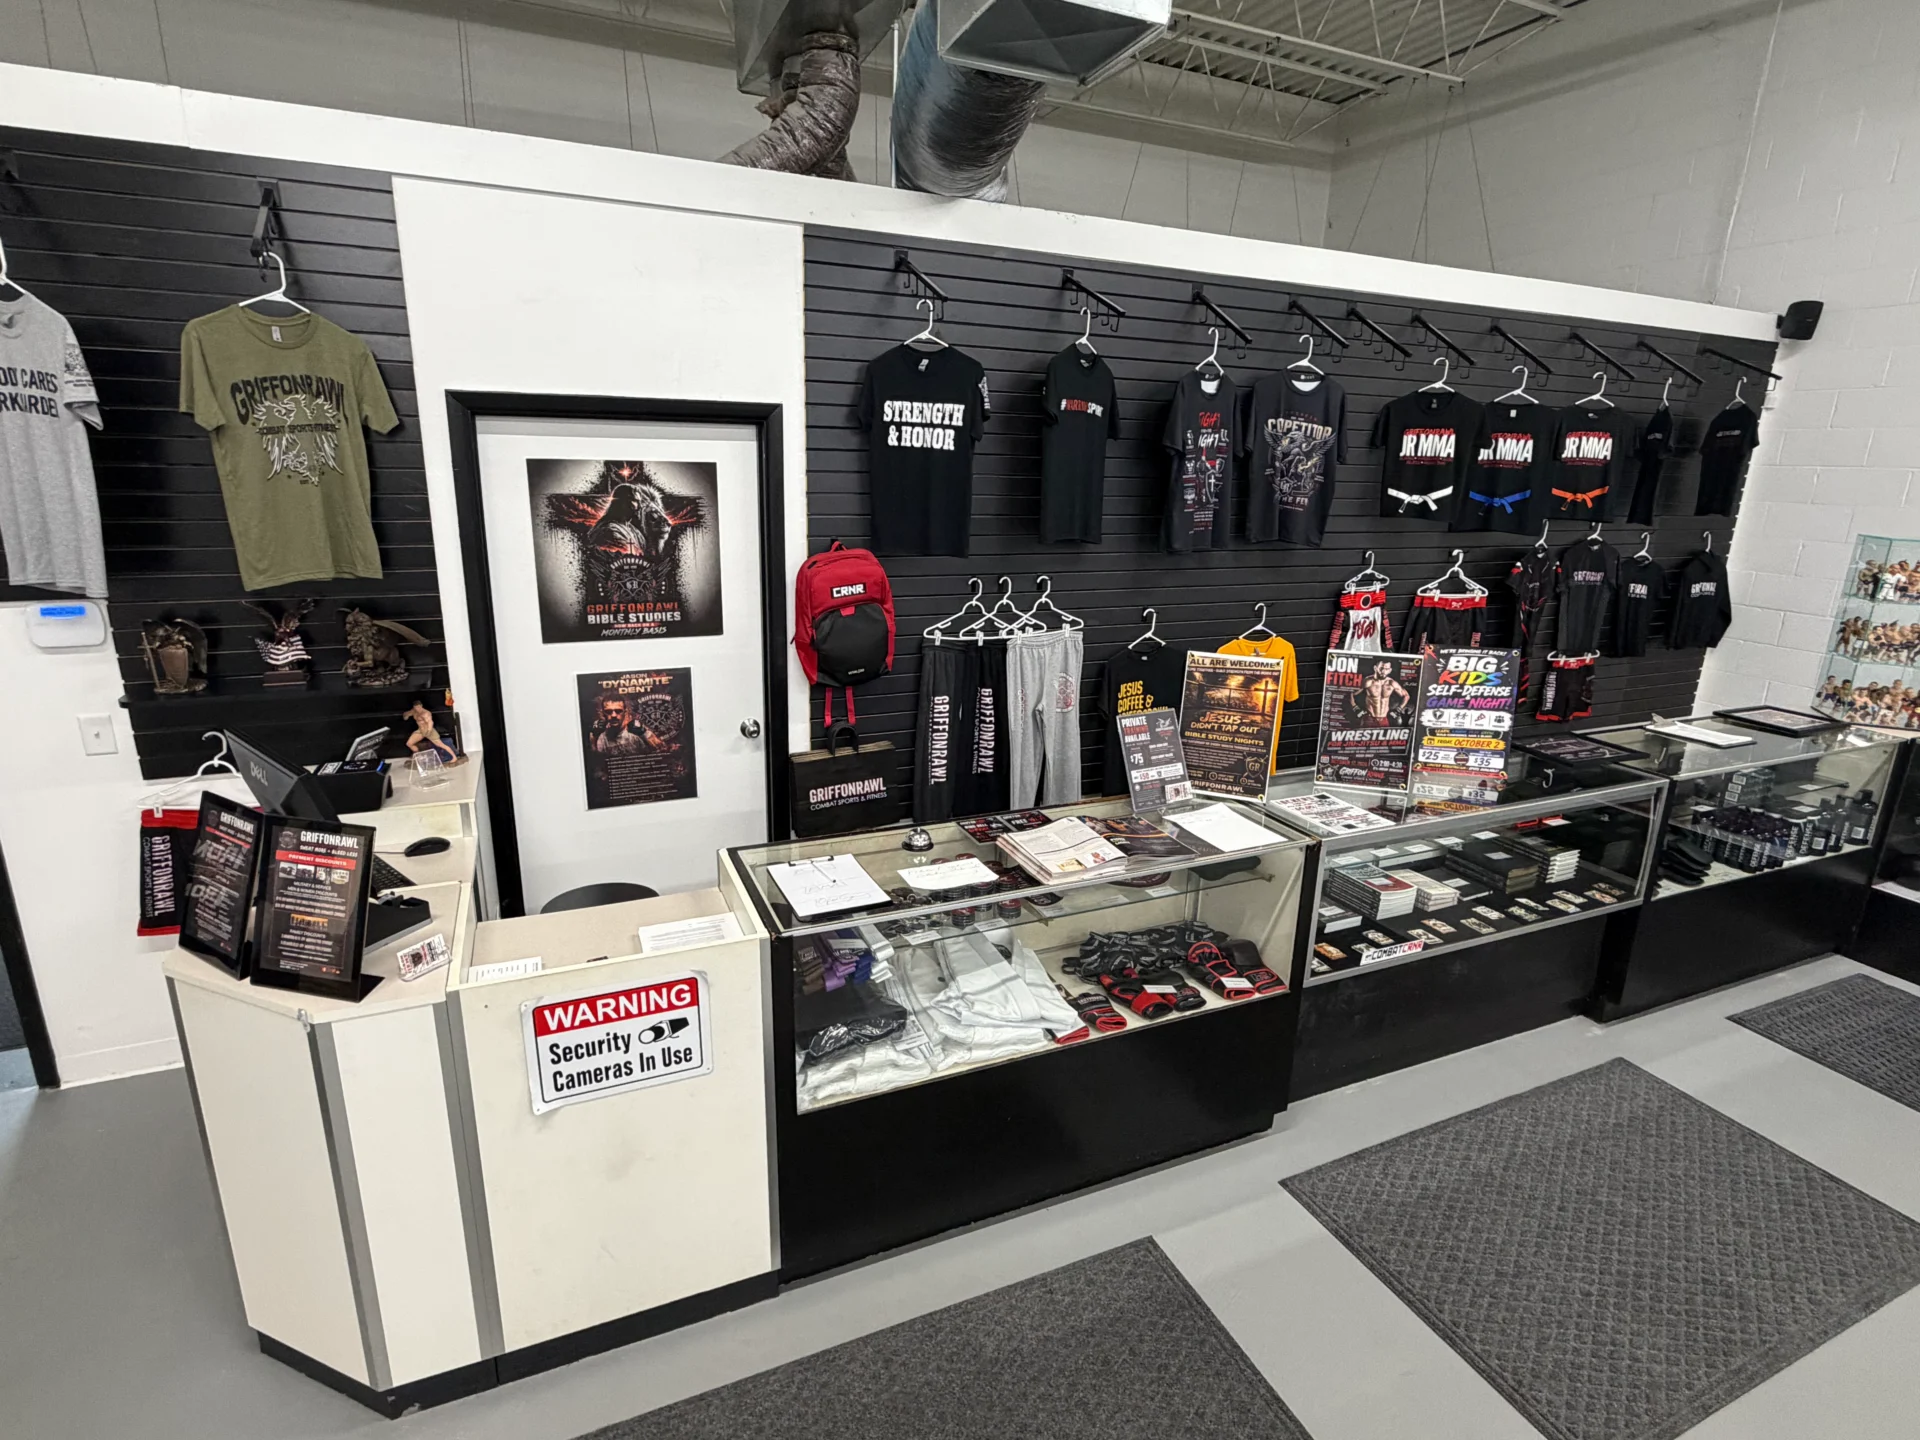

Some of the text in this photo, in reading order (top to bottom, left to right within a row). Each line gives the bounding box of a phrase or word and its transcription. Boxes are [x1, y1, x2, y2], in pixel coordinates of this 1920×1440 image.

[21, 368, 58, 394] CARES
[883, 400, 966, 427] STRENGTH
[887, 425, 955, 451] & HONOR
[1399, 433, 1456, 458] JR MMA
[1496, 438, 1534, 462] MMA
[1562, 437, 1613, 460] JR MMA
[587, 611, 682, 624] BIBLE STUDIES
[601, 626, 667, 636] MONTHLY BASIS
[1190, 658, 1275, 669] ALL ARE WELCOME
[1328, 657, 1359, 673] JON
[1446, 656, 1498, 673] BIG
[1326, 672, 1363, 687] FITCH
[1438, 670, 1504, 686] KIDS
[619, 685, 653, 694] DENT
[1118, 681, 1143, 698] JESUS
[1426, 684, 1512, 697] SELF-DEFENSE
[1118, 695, 1145, 713] COFFEE
[1145, 694, 1154, 708] &
[1426, 696, 1513, 709] GAME NIGHT!
[1121, 716, 1148, 728] PRIVATE
[1200, 712, 1242, 724] JESUS
[978, 688, 995, 773] GRIFFONRAWL
[1190, 721, 1260, 735] DIDN'T TAP OUT
[1331, 729, 1410, 741] WRESTLING
[931, 695, 950, 785] GRIFFONRAWL
[1124, 732, 1151, 743] AVAILABLE
[1208, 733, 1234, 742] STUDY
[1234, 737, 1264, 746] NIGHTS
[1453, 739, 1492, 748] OCTOBER
[1493, 741, 1500, 749] 2
[1130, 752, 1144, 764] $75
[1421, 750, 1440, 760] $25
[1473, 757, 1492, 767] $35
[250, 761, 269, 786] DELL
[1339, 766, 1368, 777] GRIFFON
[809, 777, 886, 803] GRIFFONRAWL
[810, 800, 837, 811] COMBAT
[838, 796, 860, 806] SPORTS
[866, 792, 887, 800] FITNESS
[220, 811, 255, 835] GRIFFONRAWL
[300, 831, 359, 849] GRIFFONRAWL
[1784, 826, 1799, 858] DEFENSE
[1800, 822, 1814, 854] DEFENSE
[143, 837, 152, 866] COMBAT
[315, 857, 347, 866] DISCOUNTS
[144, 866, 152, 889] SPORTS
[151, 835, 175, 917] GRIFFONRAWL
[145, 896, 153, 918] FITNESS
[543, 983, 693, 1032] WARNING
[549, 1030, 632, 1066] Security
[552, 1045, 693, 1093] Cameras In Use
